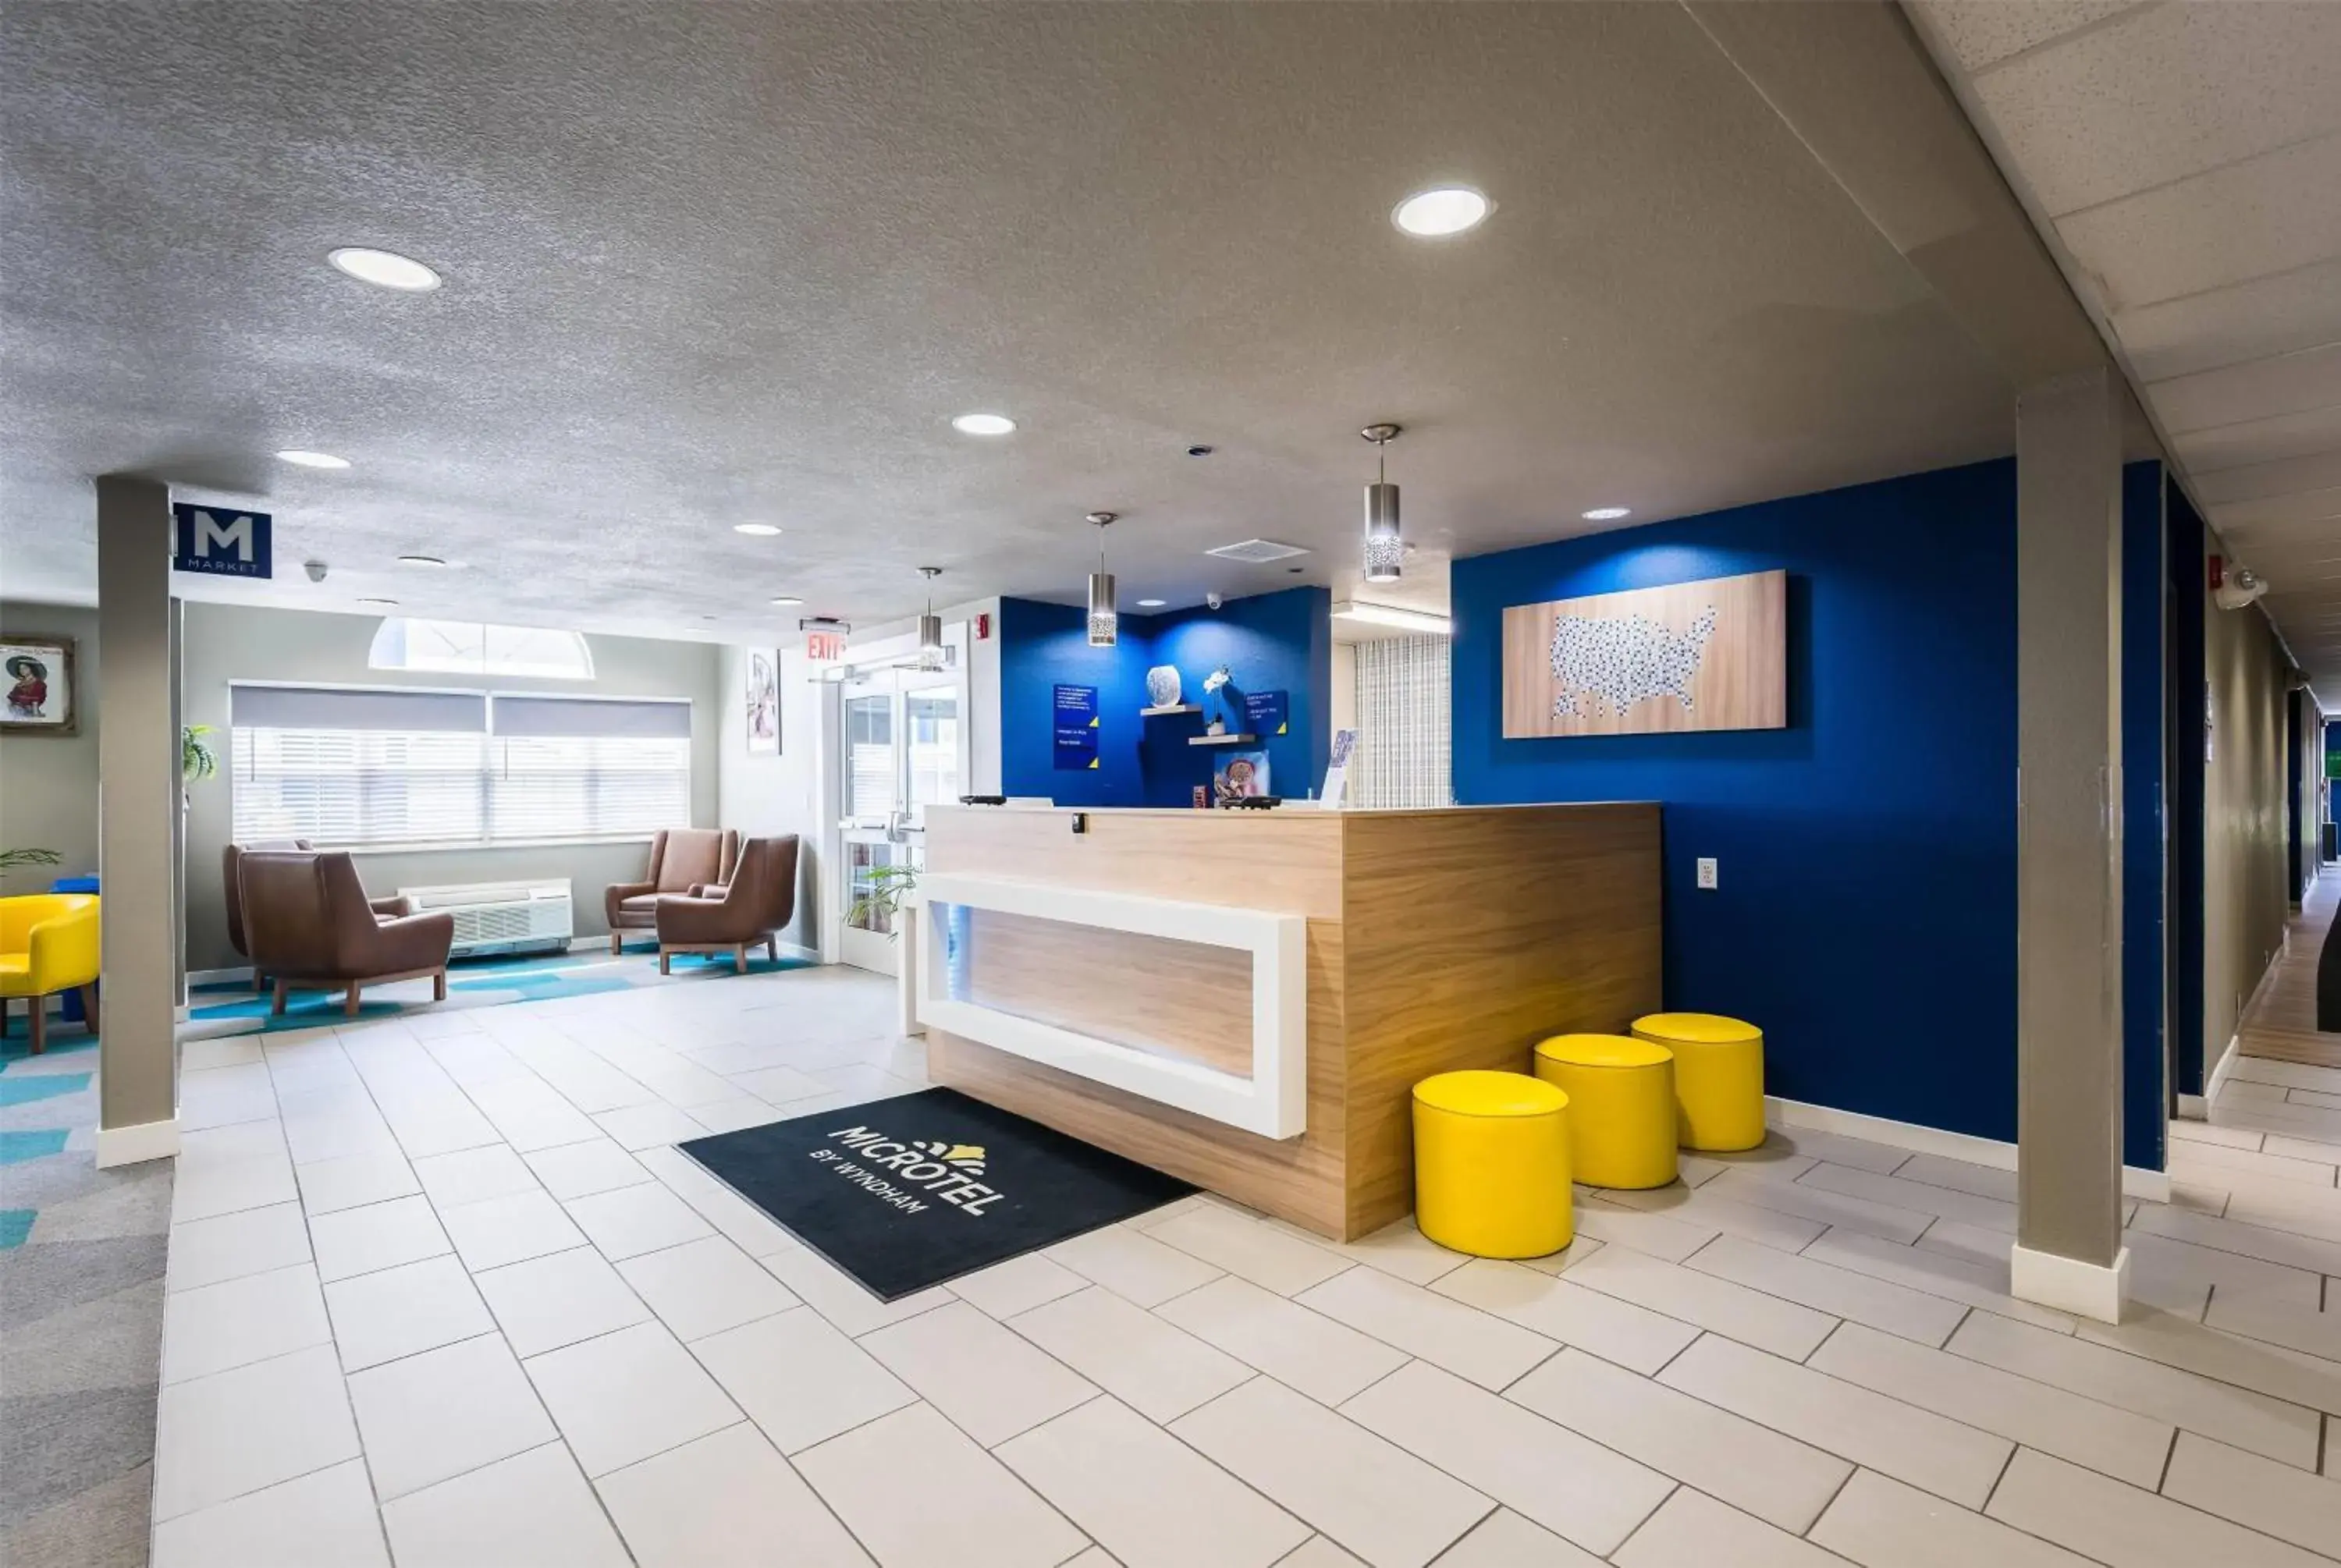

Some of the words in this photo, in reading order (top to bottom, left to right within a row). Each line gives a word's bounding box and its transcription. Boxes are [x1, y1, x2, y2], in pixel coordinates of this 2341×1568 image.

[194, 510, 253, 562] M
[188, 558, 258, 573] MARKET
[808, 634, 840, 661] EXIT
[809, 1148, 843, 1163] BY
[833, 1162, 929, 1215] WYNDHAM
[827, 1126, 1005, 1216] MICROTEL
